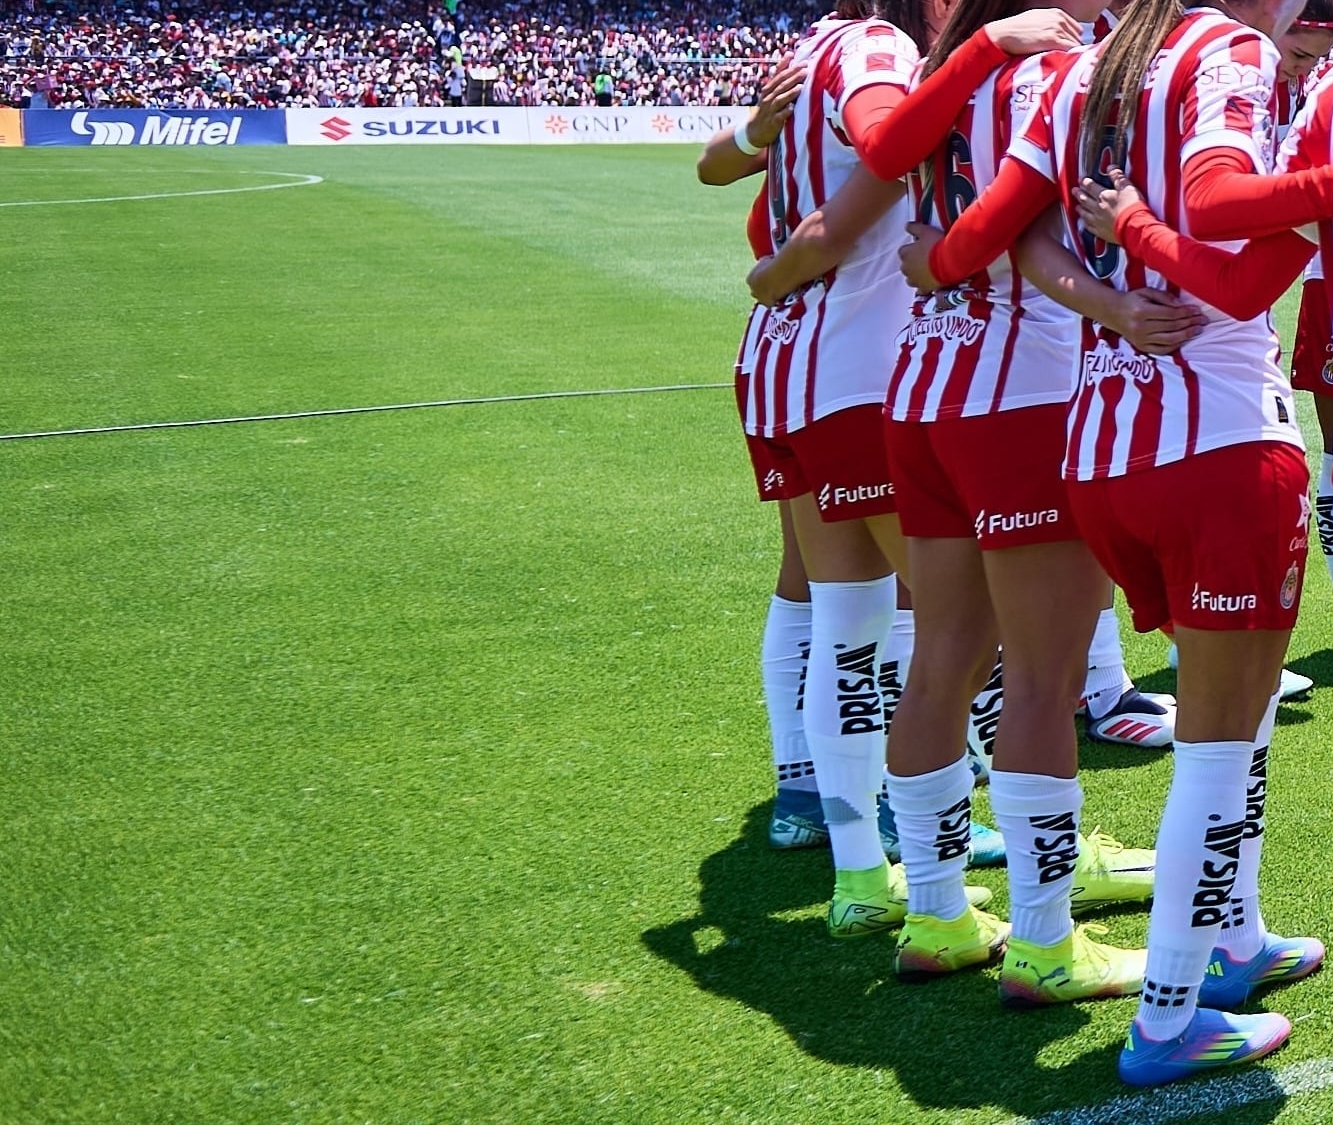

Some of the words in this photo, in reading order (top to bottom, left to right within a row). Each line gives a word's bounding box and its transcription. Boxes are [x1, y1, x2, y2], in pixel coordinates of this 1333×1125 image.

[140, 115, 243, 146] Mifel
[362, 119, 501, 137] SUZUKI
[572, 114, 629, 133] GNP
[678, 113, 733, 132] GNP
[987, 507, 1059, 535] Futura
[1200, 590, 1257, 612] Futura
